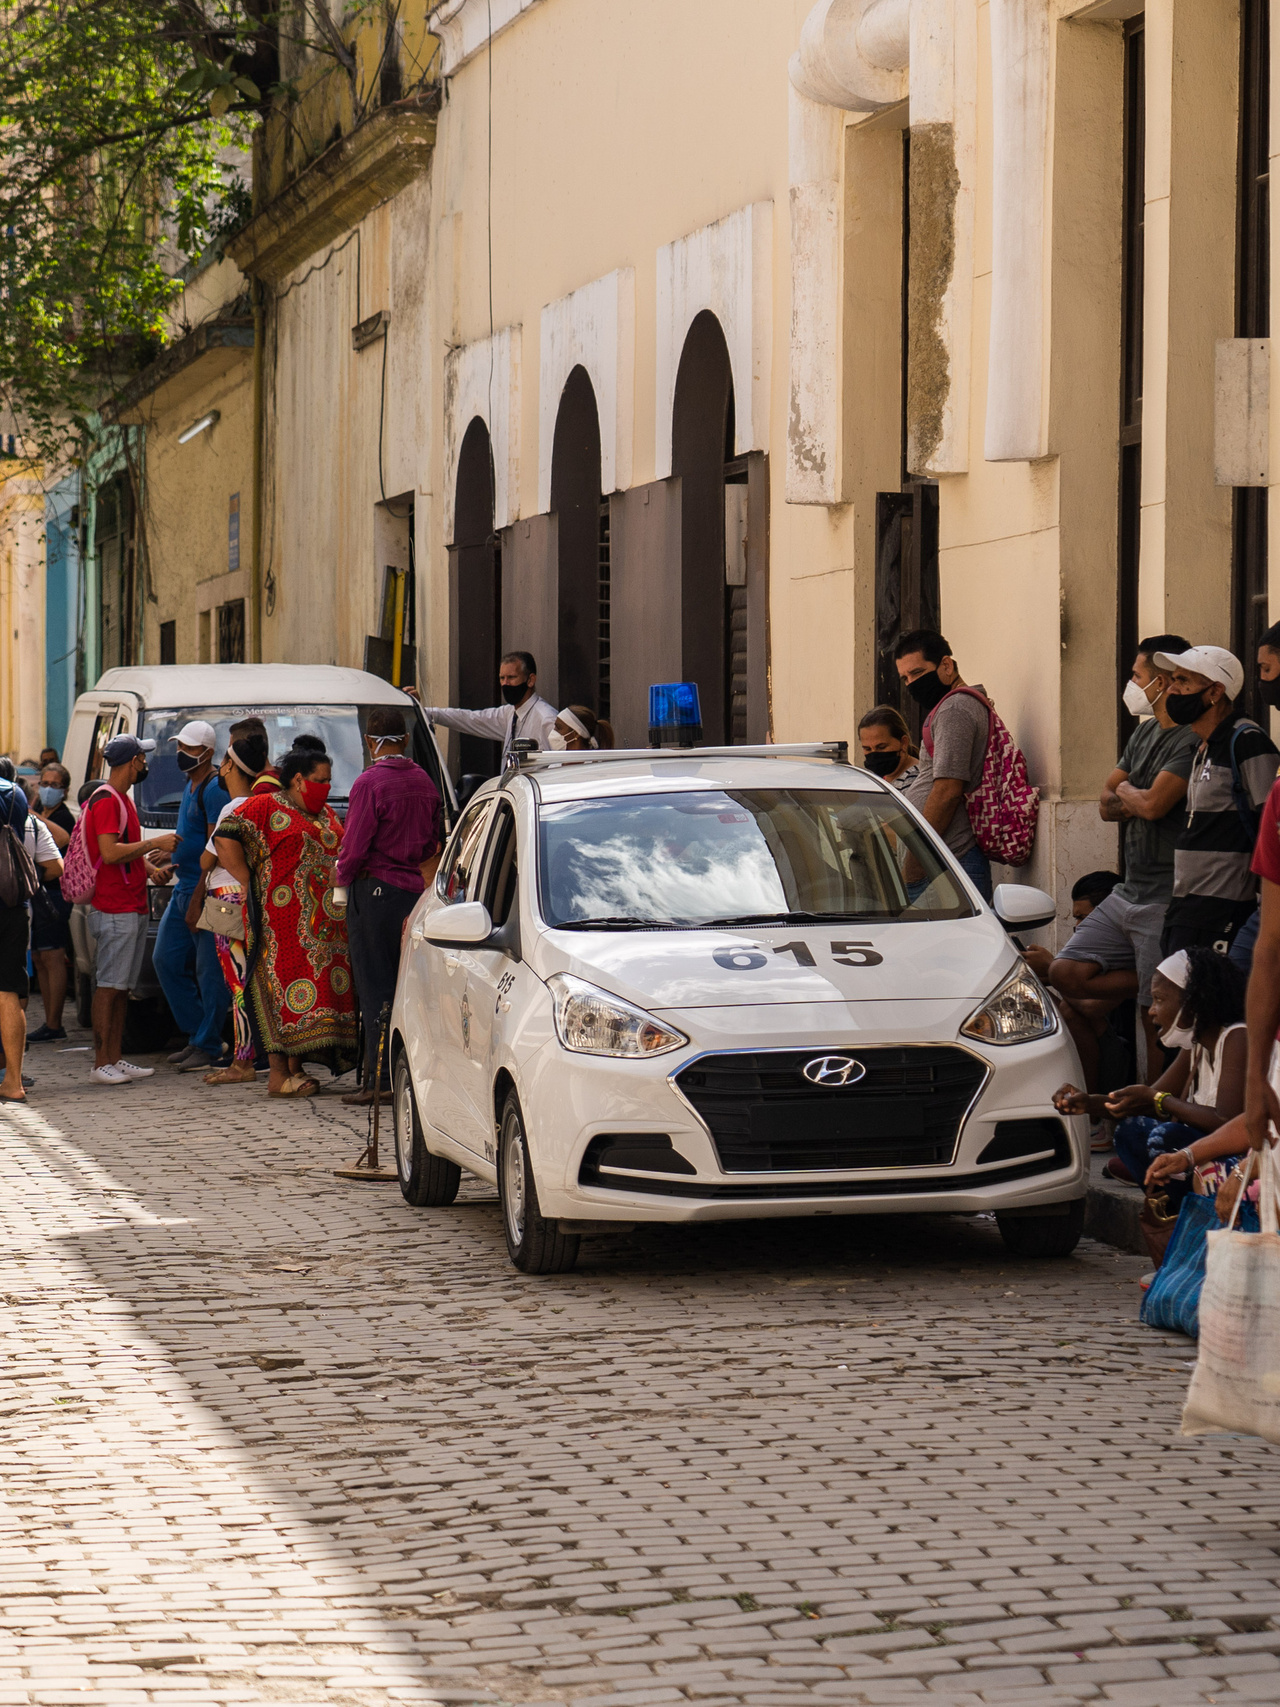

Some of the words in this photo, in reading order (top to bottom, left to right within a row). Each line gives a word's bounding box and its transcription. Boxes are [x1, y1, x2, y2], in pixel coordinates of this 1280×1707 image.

[245, 706, 318, 716] Mercedes-Benz
[712, 941, 884, 971] 615
[497, 971, 516, 995] 615
